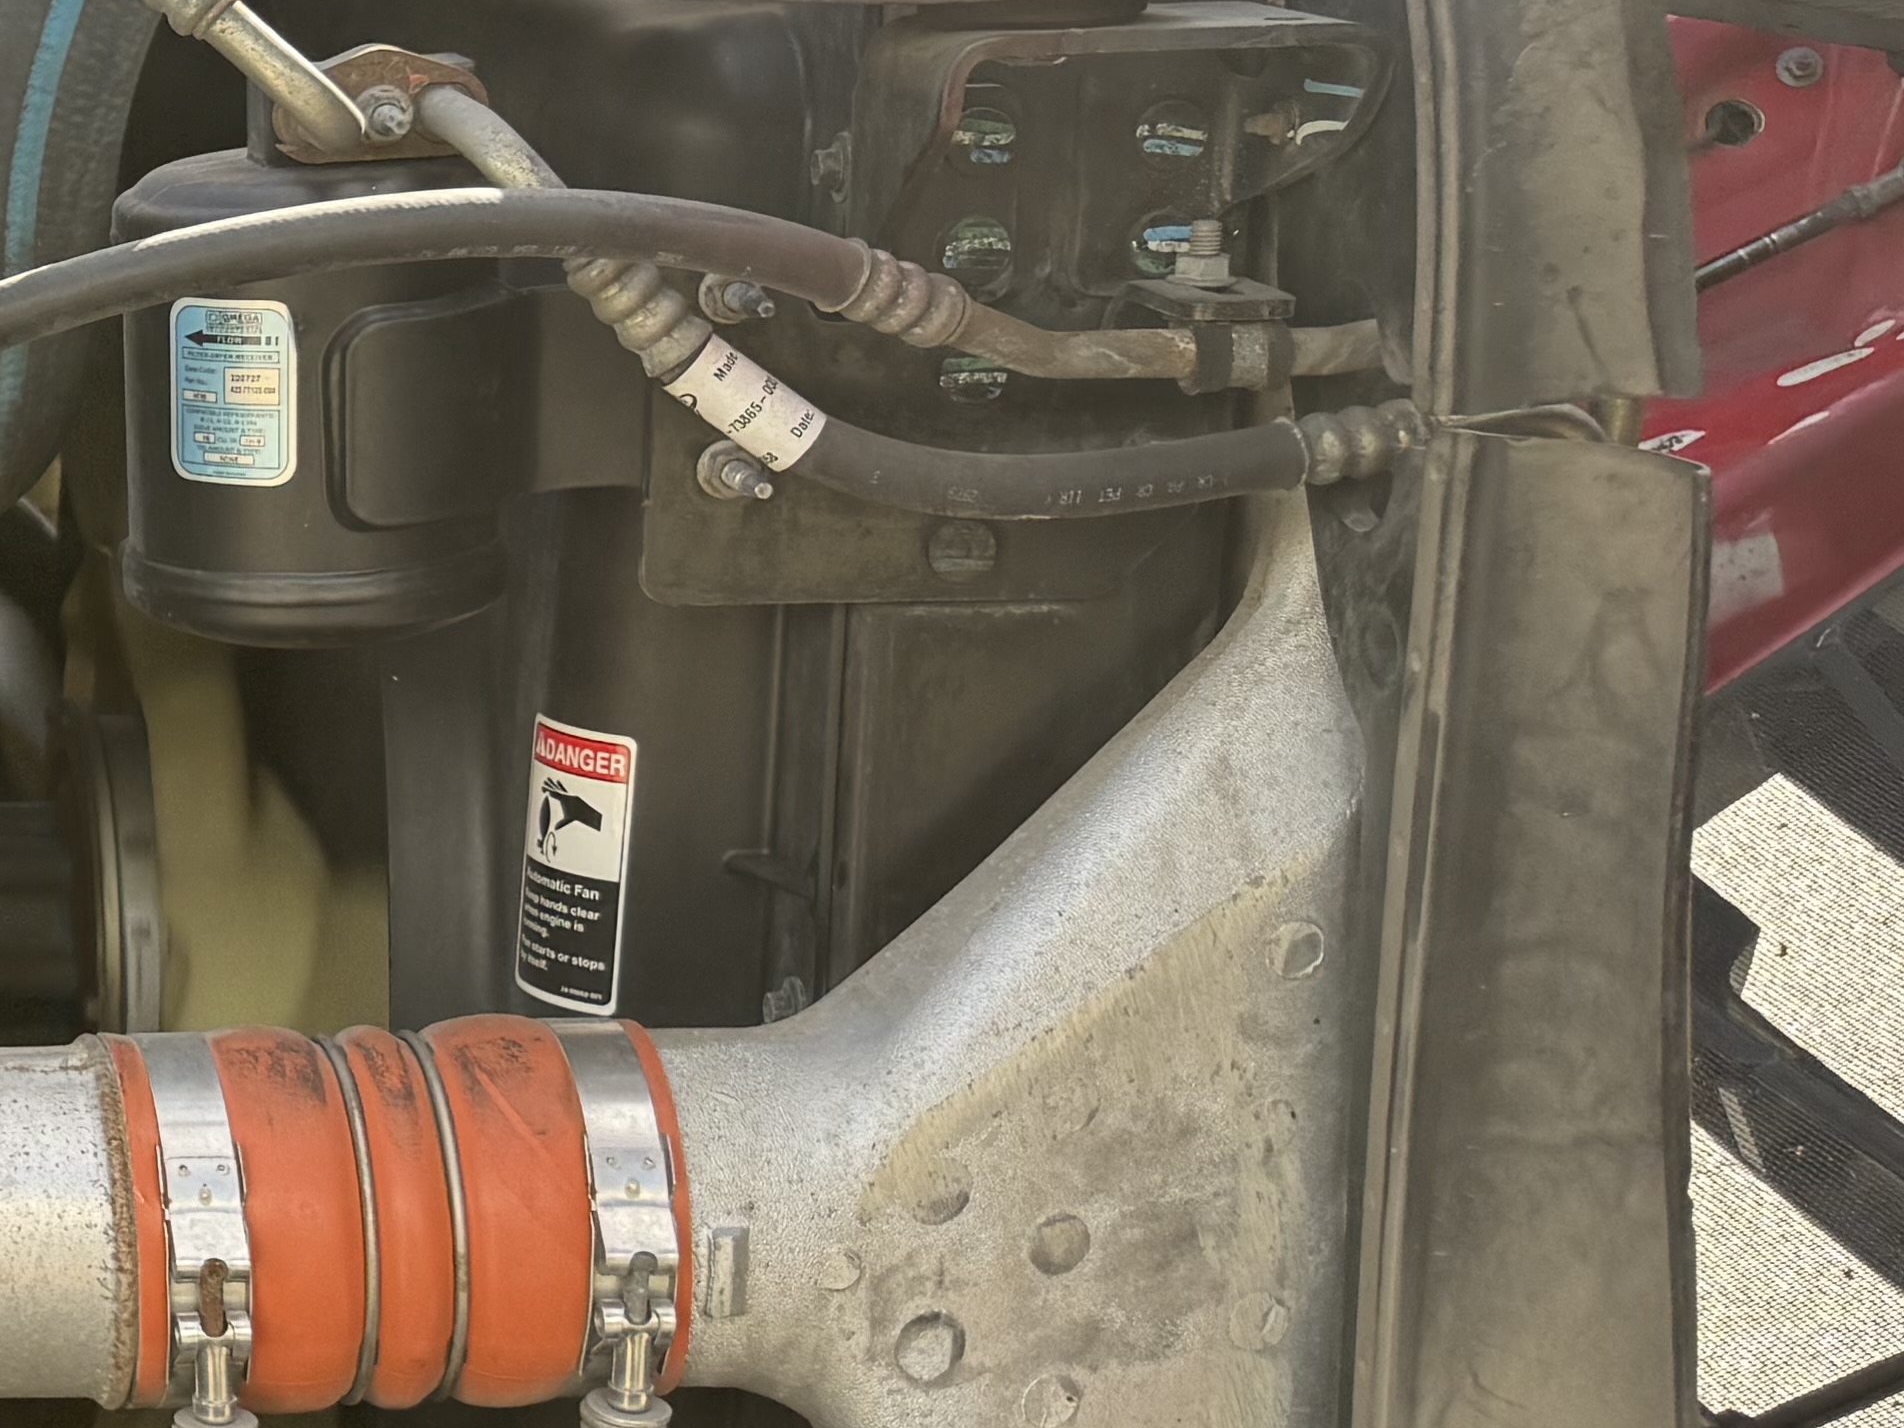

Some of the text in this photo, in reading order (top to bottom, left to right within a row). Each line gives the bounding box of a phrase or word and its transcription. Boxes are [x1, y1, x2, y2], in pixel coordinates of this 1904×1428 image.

[713, 352, 738, 382] Made
[546, 738, 626, 777] DANGER
[527, 866, 600, 900] Automatic Fan
[540, 894, 568, 913] hands
[570, 906, 600, 920] clear
[539, 912, 572, 929] engine
[573, 920, 584, 932] is
[557, 952, 569, 962] or
[572, 955, 605, 971] stops
